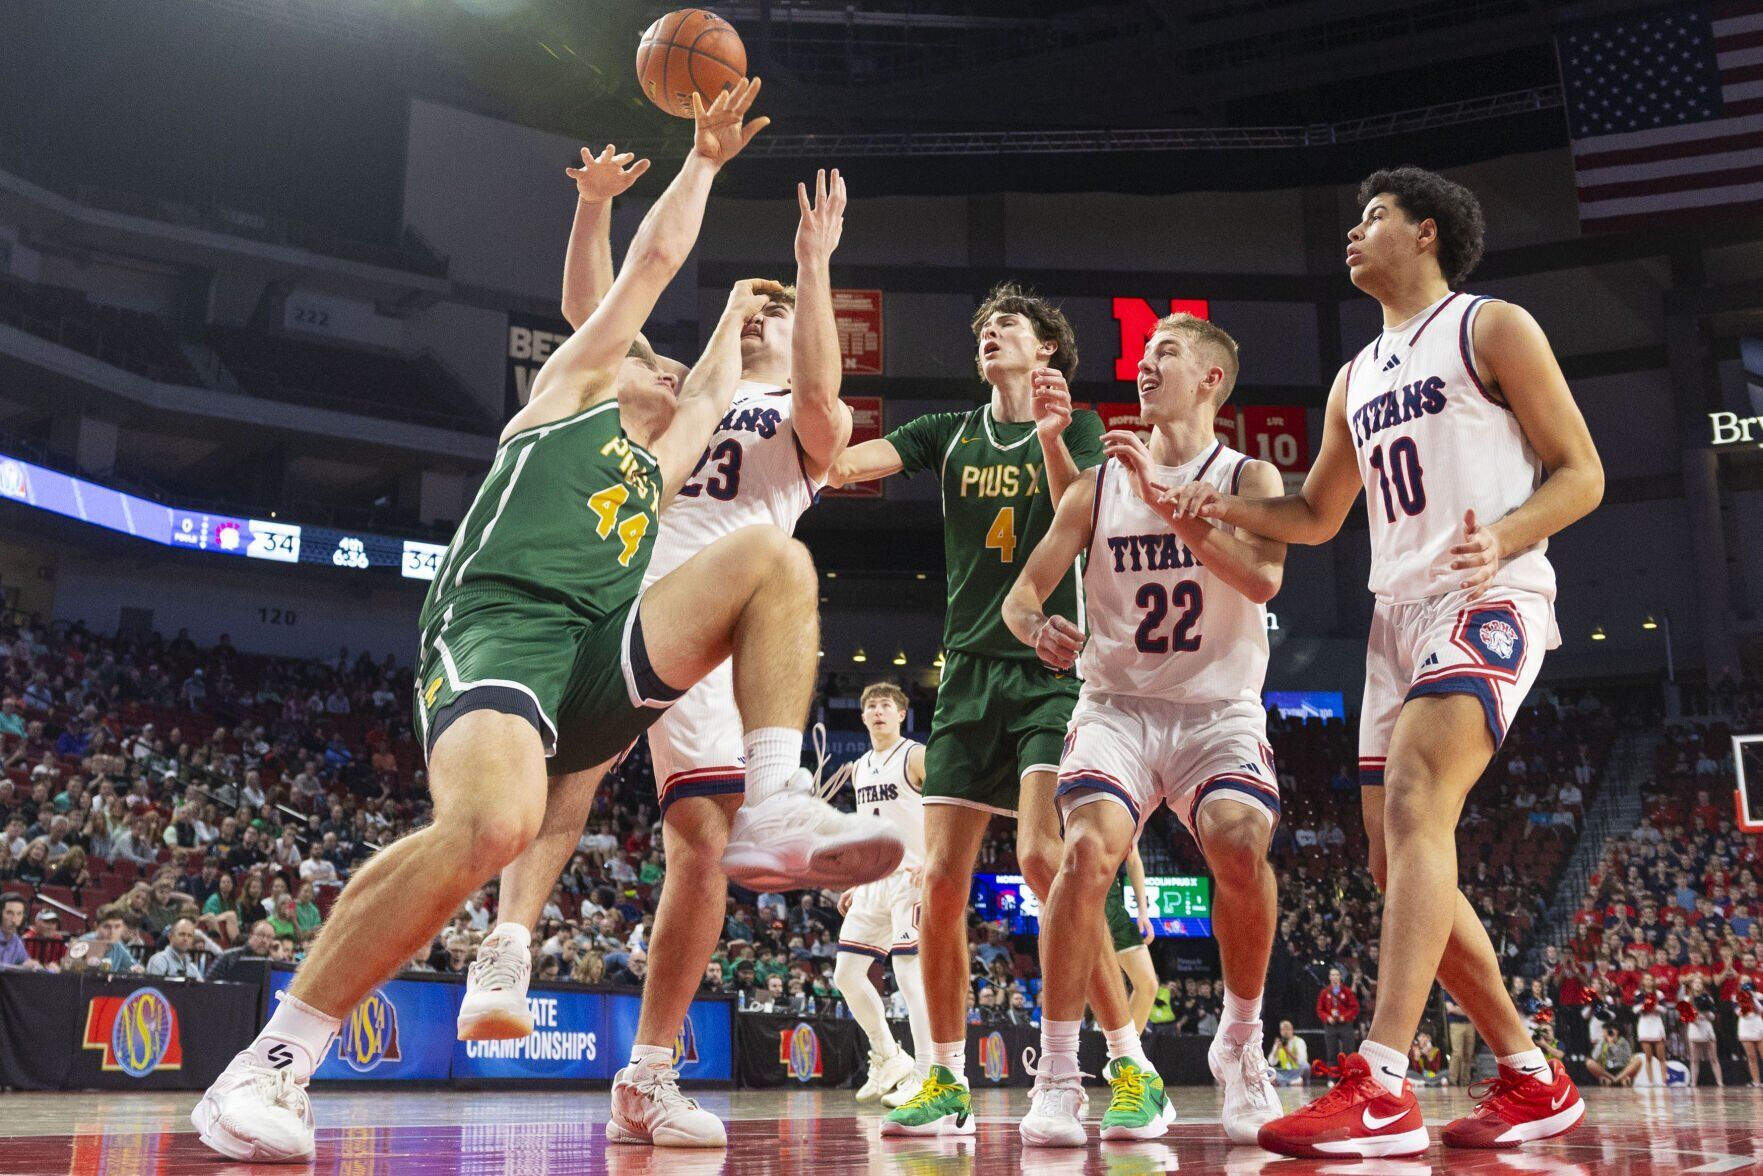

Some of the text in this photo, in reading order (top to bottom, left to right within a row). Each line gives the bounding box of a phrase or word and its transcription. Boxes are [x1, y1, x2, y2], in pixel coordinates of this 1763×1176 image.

[508, 326, 572, 362] BE
[712, 407, 783, 440] ANS
[1352, 375, 1448, 449] TITANS
[1256, 433, 1298, 467] 10
[960, 462, 1044, 498] PIUS X
[1369, 436, 1427, 524] 10
[263, 531, 294, 554] 34
[587, 483, 650, 568] 44
[985, 506, 1017, 563] 4
[332, 549, 369, 569] 6:36
[409, 551, 440, 572] 34
[1107, 533, 1204, 573] TITA
[258, 607, 297, 626] 120
[1134, 579, 1204, 655] 22
[857, 783, 899, 805] TITANS
[526, 997, 558, 1028] ATE
[466, 1031, 597, 1061] CHAMPIONSHIPS
